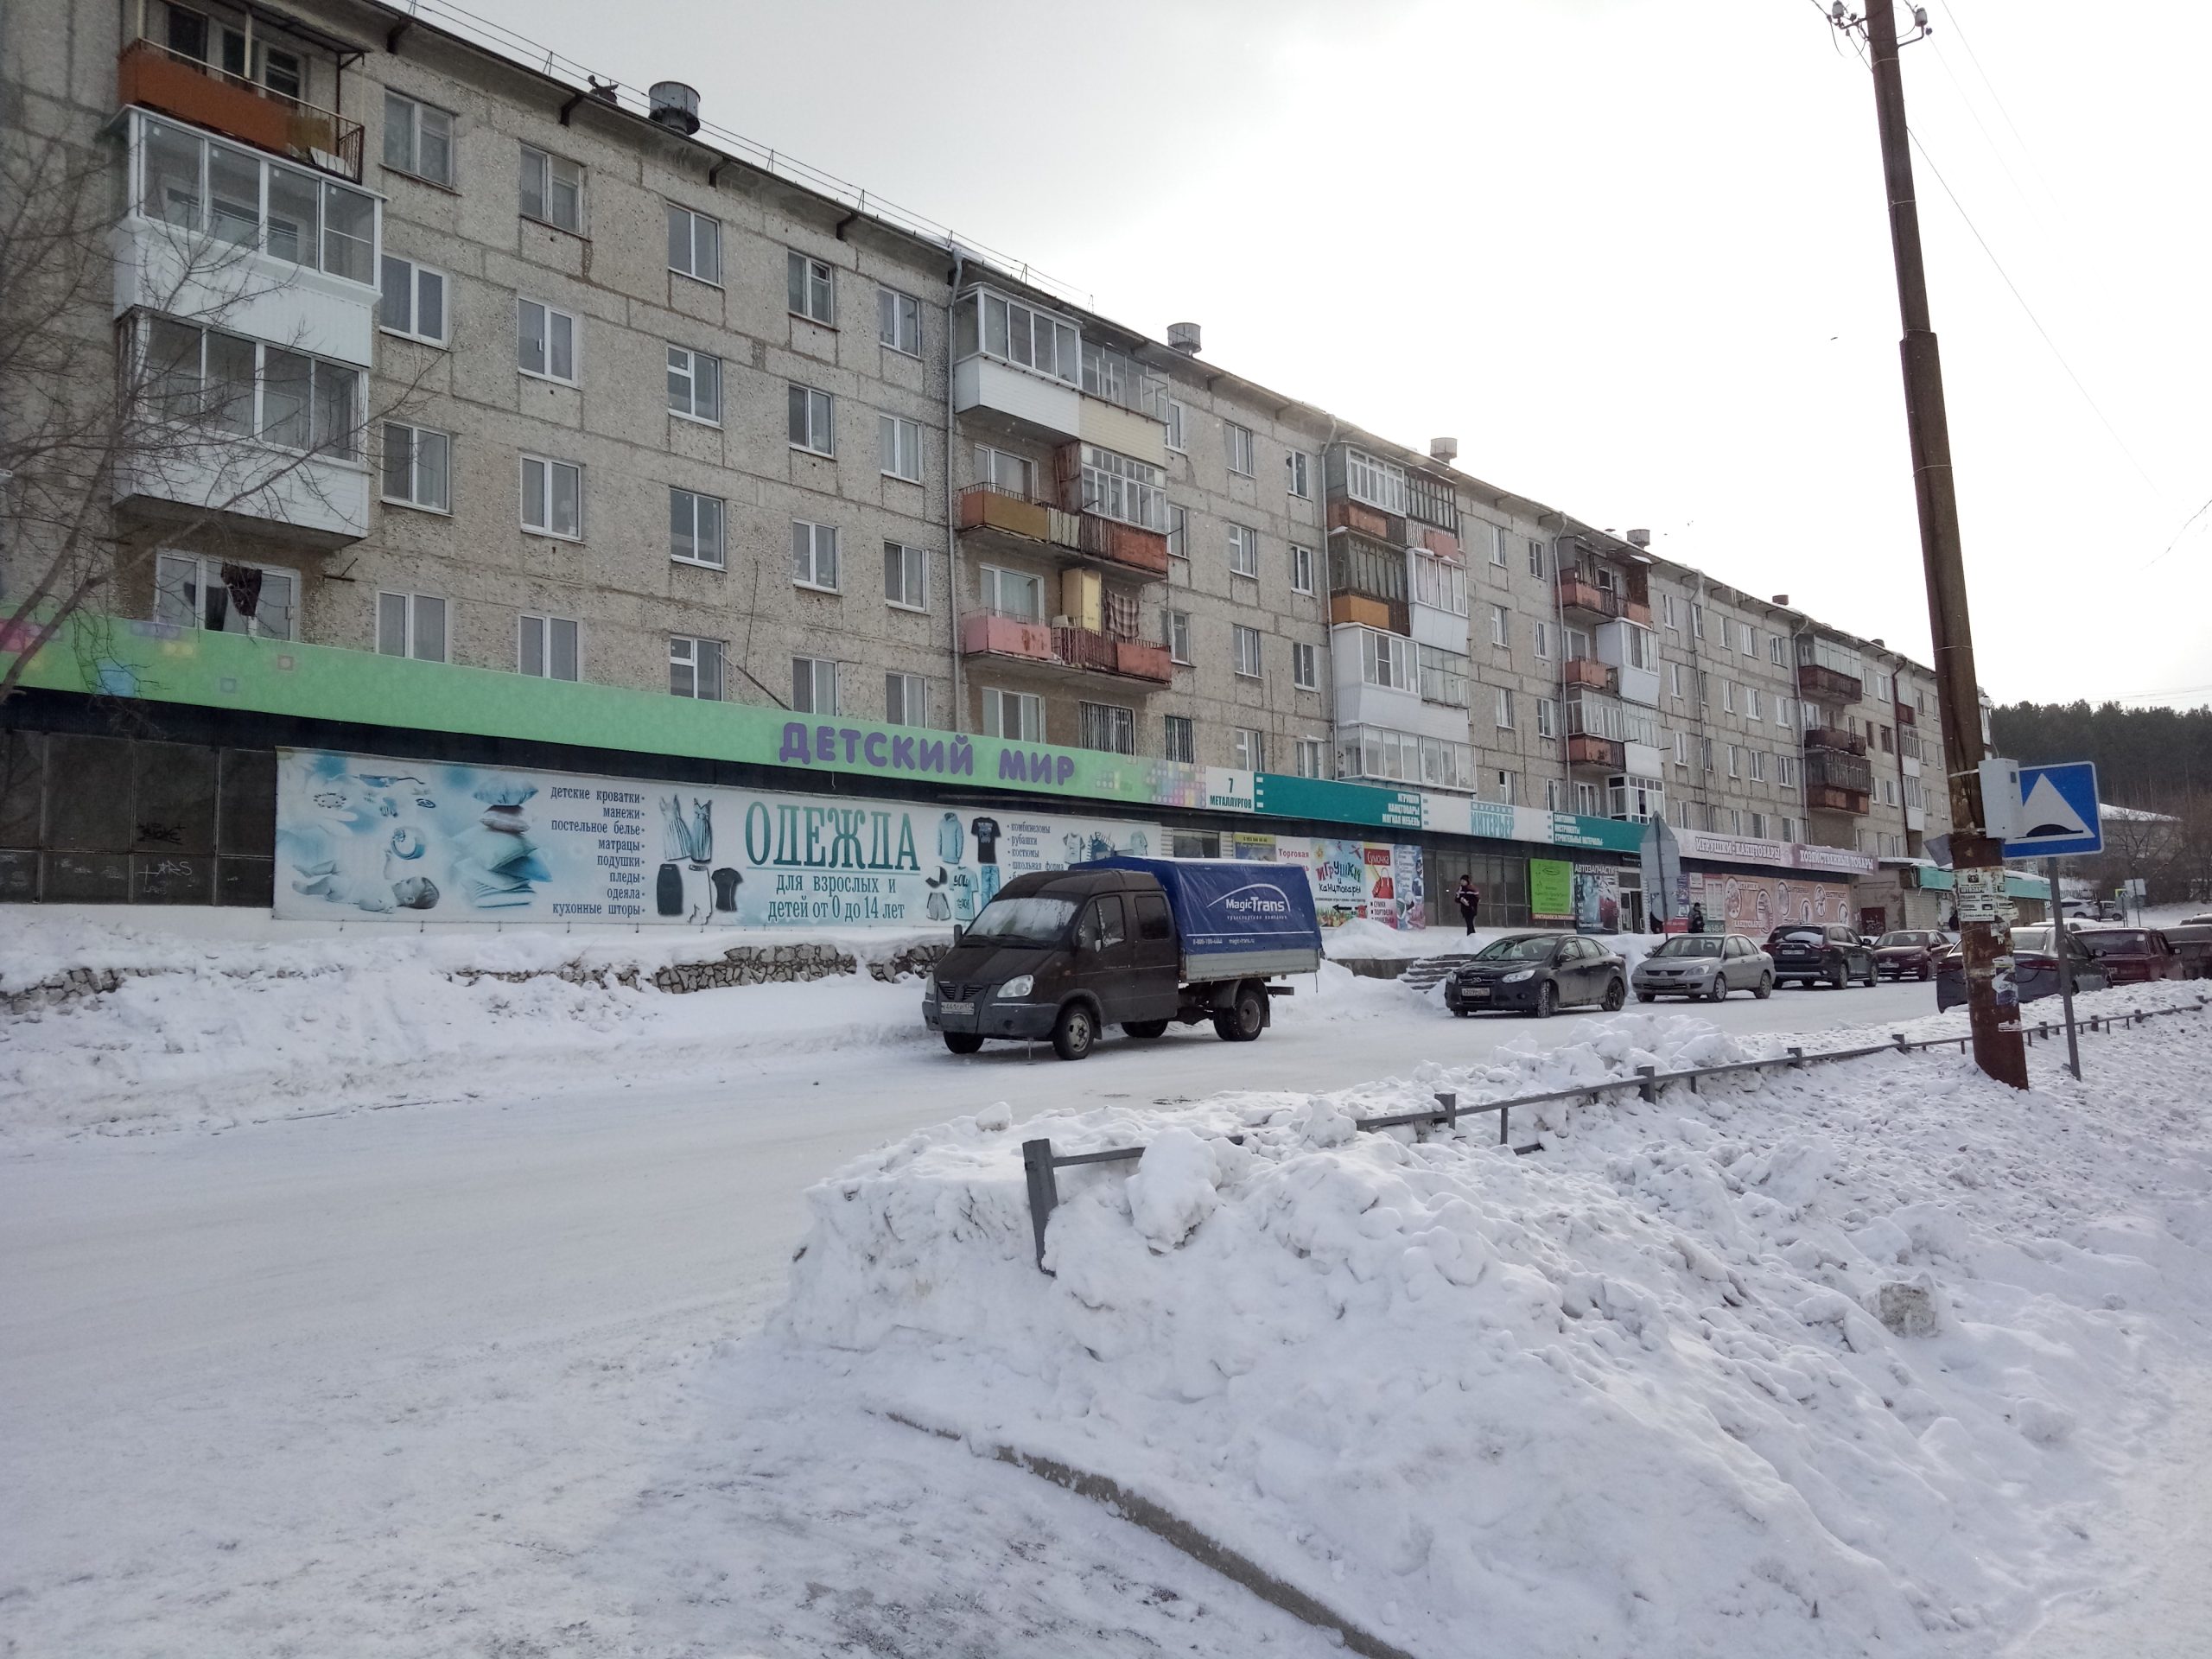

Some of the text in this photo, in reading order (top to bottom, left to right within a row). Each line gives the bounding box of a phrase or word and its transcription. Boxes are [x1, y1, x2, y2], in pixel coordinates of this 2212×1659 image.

[779, 721, 1074, 785] ДЕТСКИЙ МИР
[1228, 778, 1234, 793] 7
[550, 787, 640, 804] детские кроватки
[1210, 795, 1252, 809] МЕТАЛЛУРГОВ
[603, 807, 640, 819] манежи
[551, 820, 640, 835] постельное белье
[1011, 822, 1051, 834] комбинезоны
[1471, 811, 1514, 839] ИНТЕРЬЕР
[745, 801, 921, 871] ОДЕЖДА
[1011, 836, 1038, 846] рубашки
[598, 839, 640, 853] матрацы
[1012, 849, 1039, 857] костюмы
[1695, 837, 1780, 860] ИГРУШКИ КАНЦТОВАРЫ
[1278, 849, 1309, 859] Торговая
[1367, 851, 1389, 865] Сумочка
[1799, 849, 1874, 870] ХОЗЯЙСТВЕННЫЕ ТОВАРЫ
[597, 855, 640, 869] подушки
[1574, 864, 1615, 874] АВТОЗАПЧАСТИ
[609, 872, 640, 884] пледы
[777, 874, 896, 897] для взрослых и
[607, 888, 640, 900] одеяла
[552, 903, 640, 918] кухонные шторы
[768, 895, 905, 922] детей от 0 до 14 лет
[1225, 896, 1285, 912] MagicTrans
